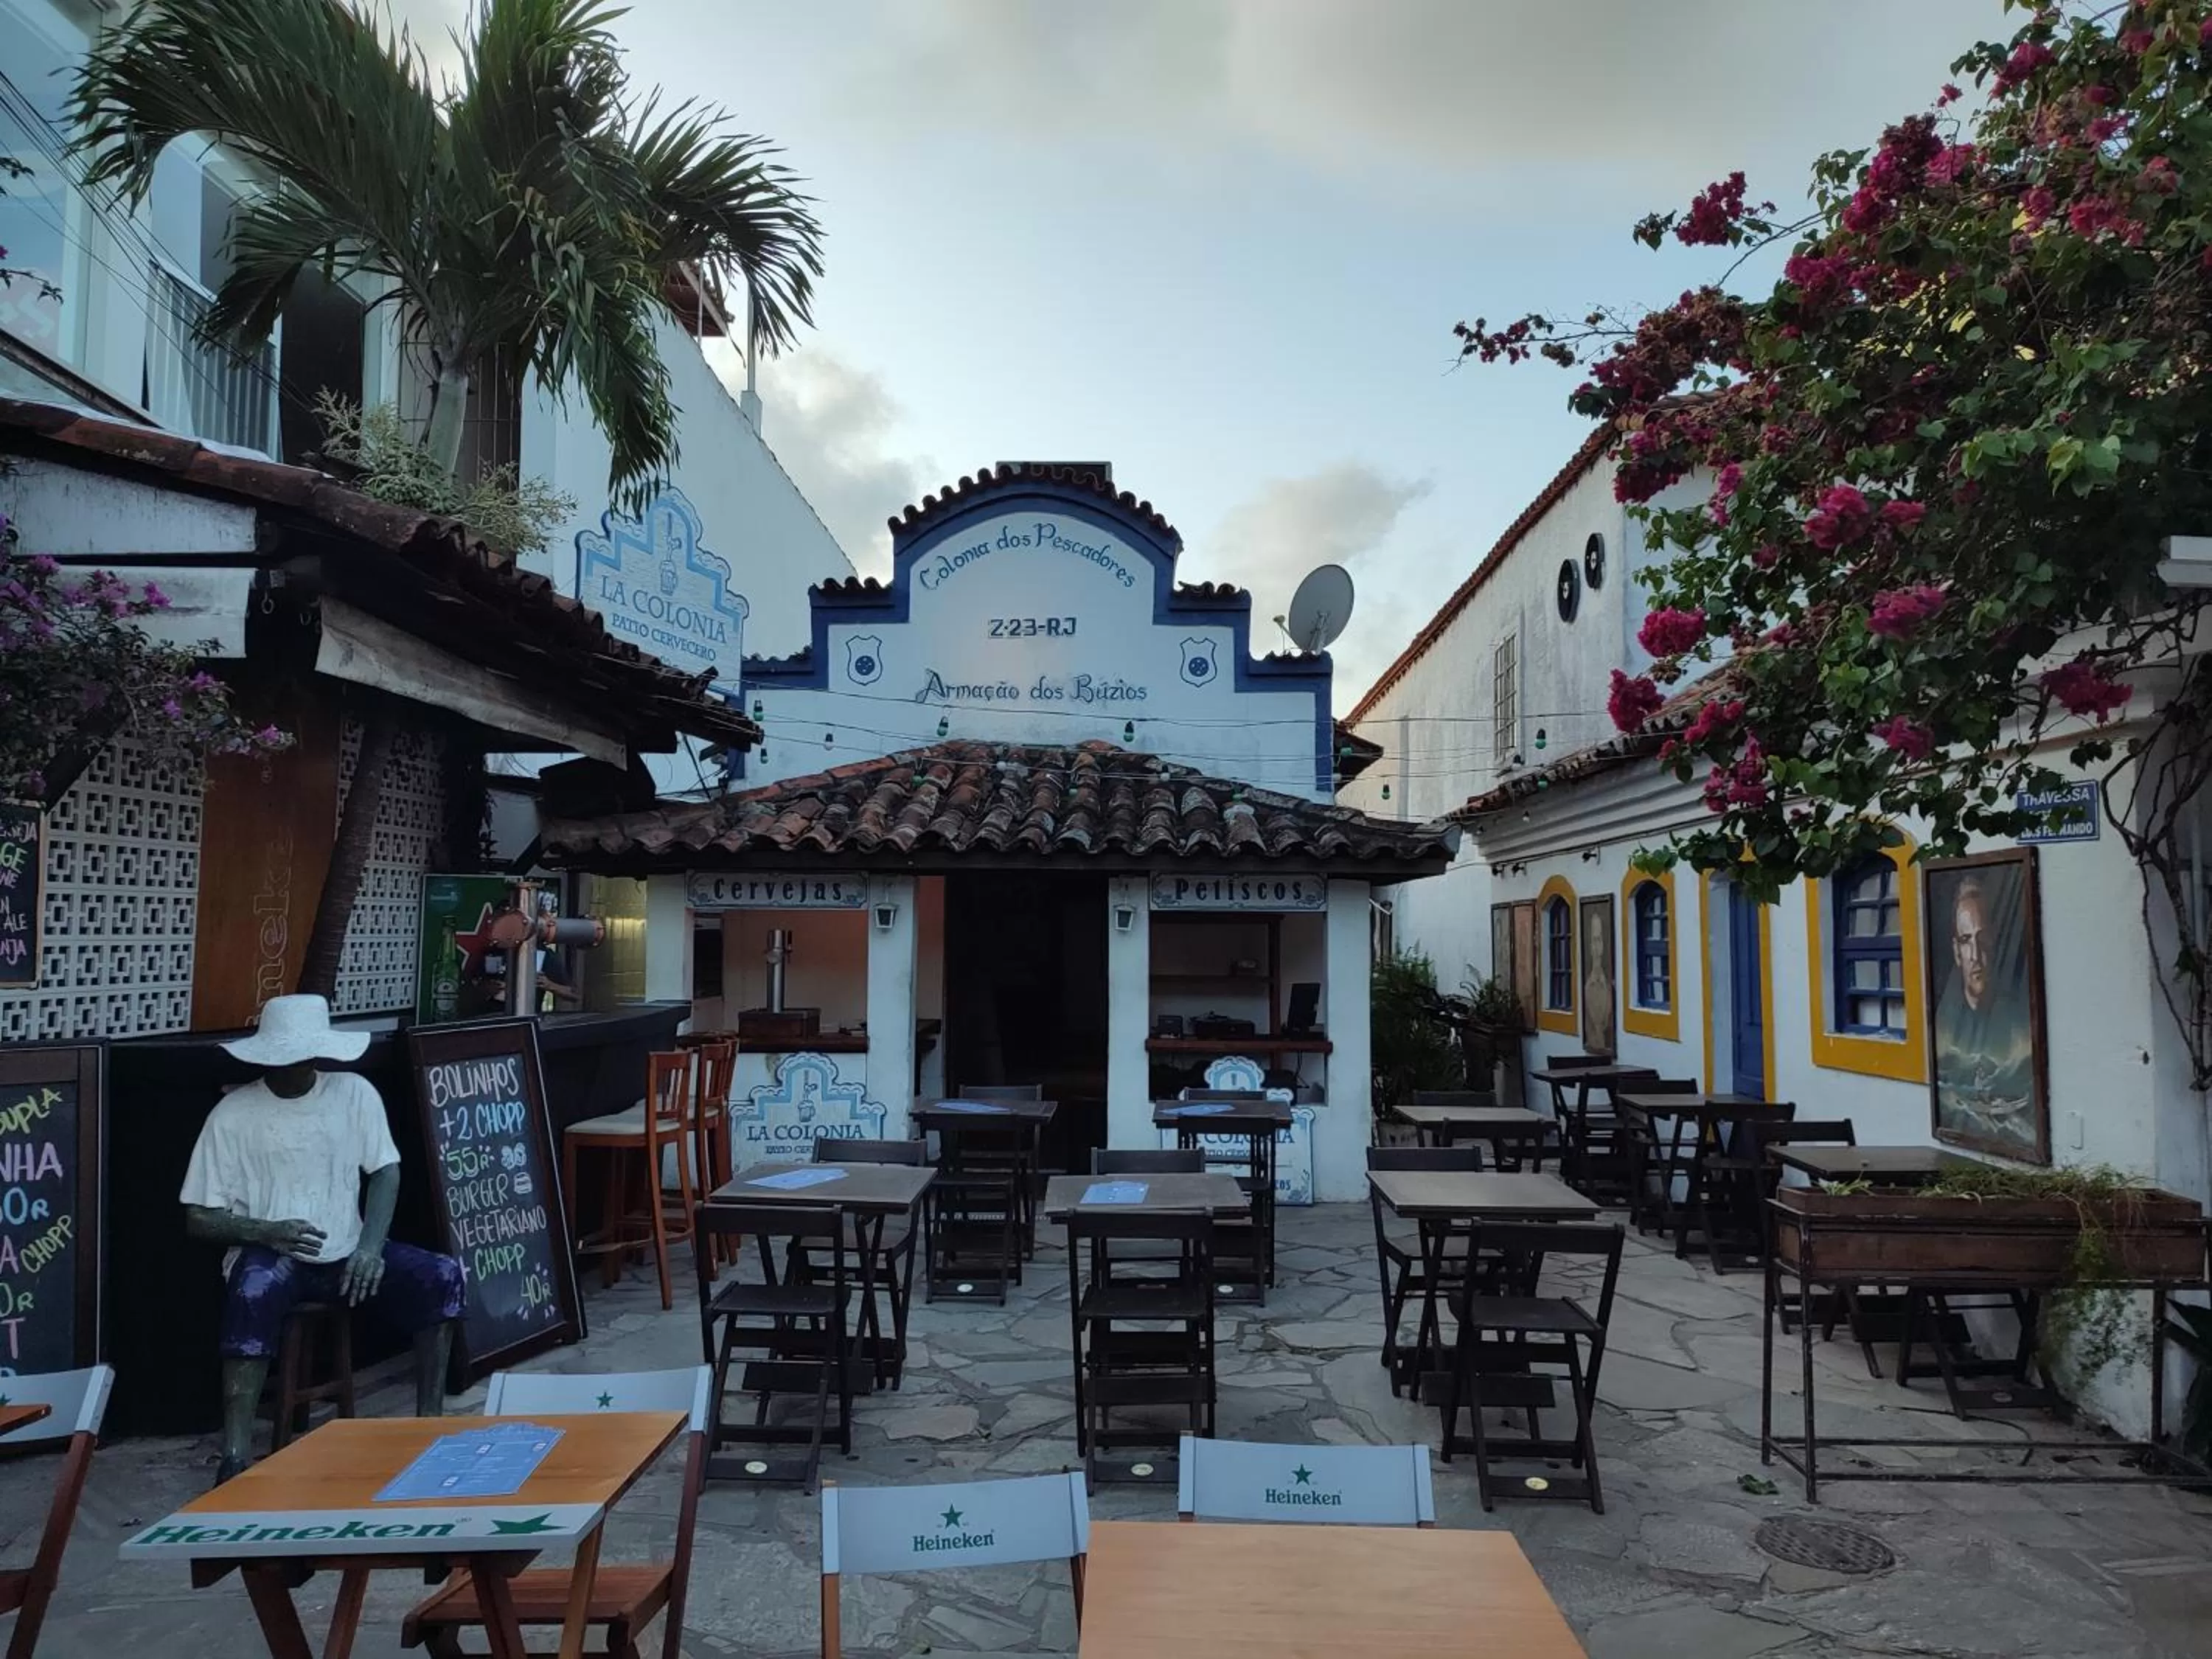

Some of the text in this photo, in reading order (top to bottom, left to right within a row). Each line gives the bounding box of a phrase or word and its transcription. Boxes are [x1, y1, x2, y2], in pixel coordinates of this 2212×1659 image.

[919, 522, 1135, 590] Colonia dos Pescadores
[600, 574, 726, 644] LA COLONIA
[612, 613, 649, 638] PATIO
[651, 628, 717, 661] CERVECERO
[916, 667, 1147, 703] Armação dos Búzios
[713, 877, 842, 902] Cervejas
[1175, 877, 1302, 900] Petiscos
[429, 1057, 519, 1107] BOLINHOS
[476, 1102, 525, 1138] CHOPP
[746, 1124, 865, 1141] LA COLONIA
[447, 1174, 508, 1217] BURGER
[20, 1214, 74, 1273] CHOPP
[450, 1205, 547, 1250] VEGETARIANO
[475, 1243, 525, 1281] CHOPP
[1265, 1488, 1341, 1506] Heineken
[142, 1520, 456, 1545] Heineken
[912, 1532, 993, 1552] Heineken
